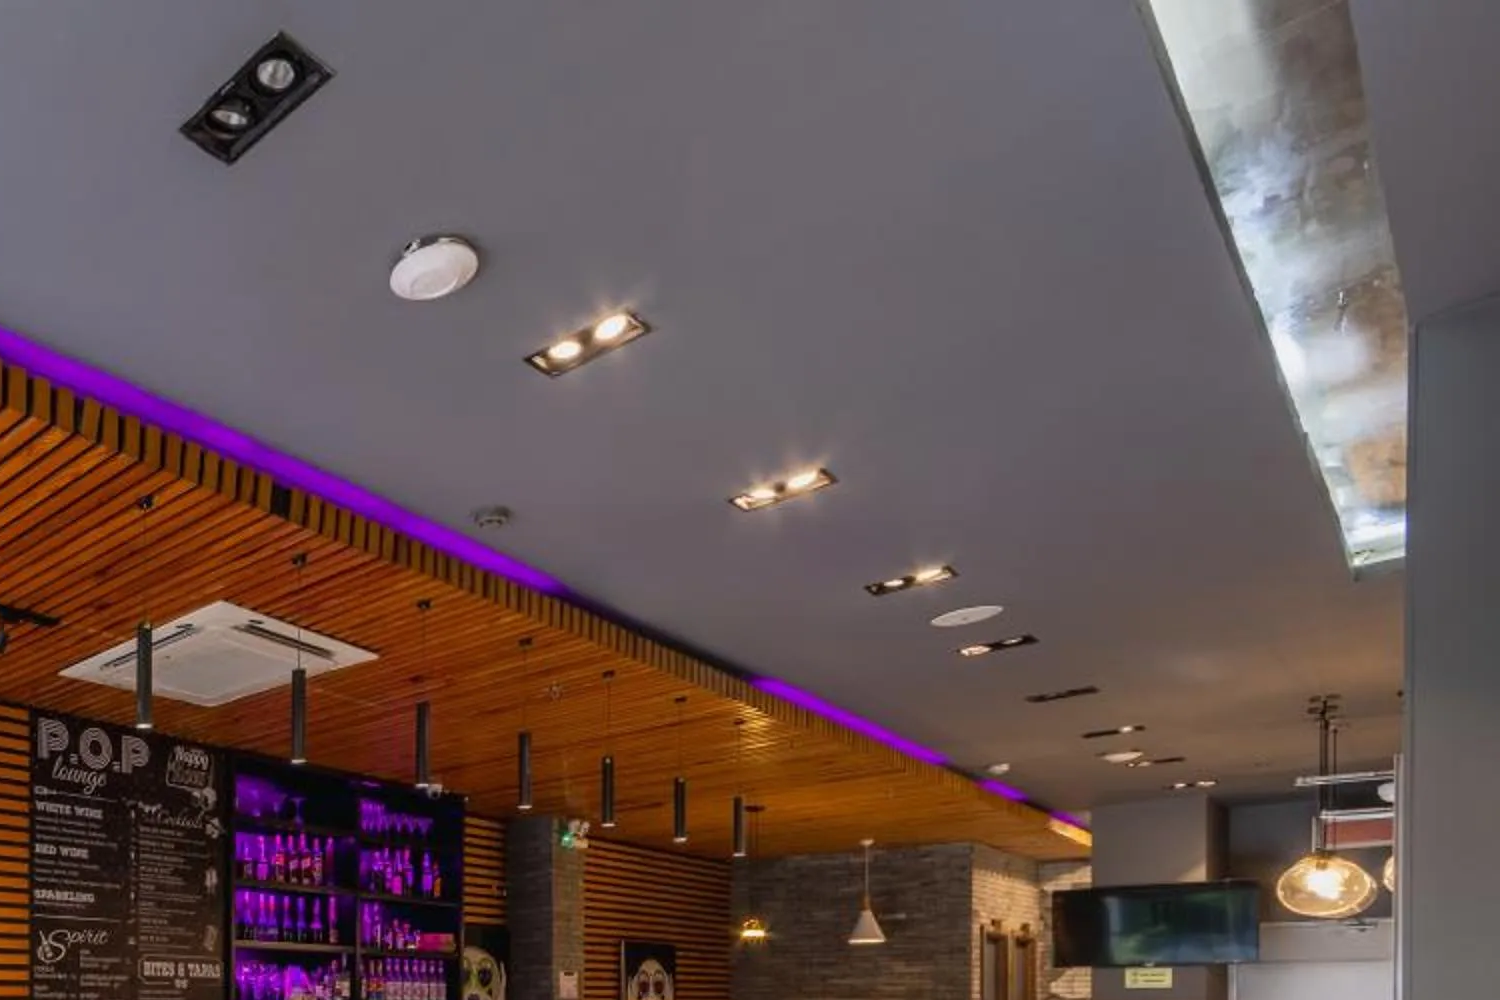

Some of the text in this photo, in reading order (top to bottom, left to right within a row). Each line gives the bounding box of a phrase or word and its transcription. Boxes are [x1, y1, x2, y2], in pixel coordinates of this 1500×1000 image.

[35, 843, 89, 859] RED WINE
[143, 960, 175, 978] BITES
[187, 962, 221, 979] TAPAS
